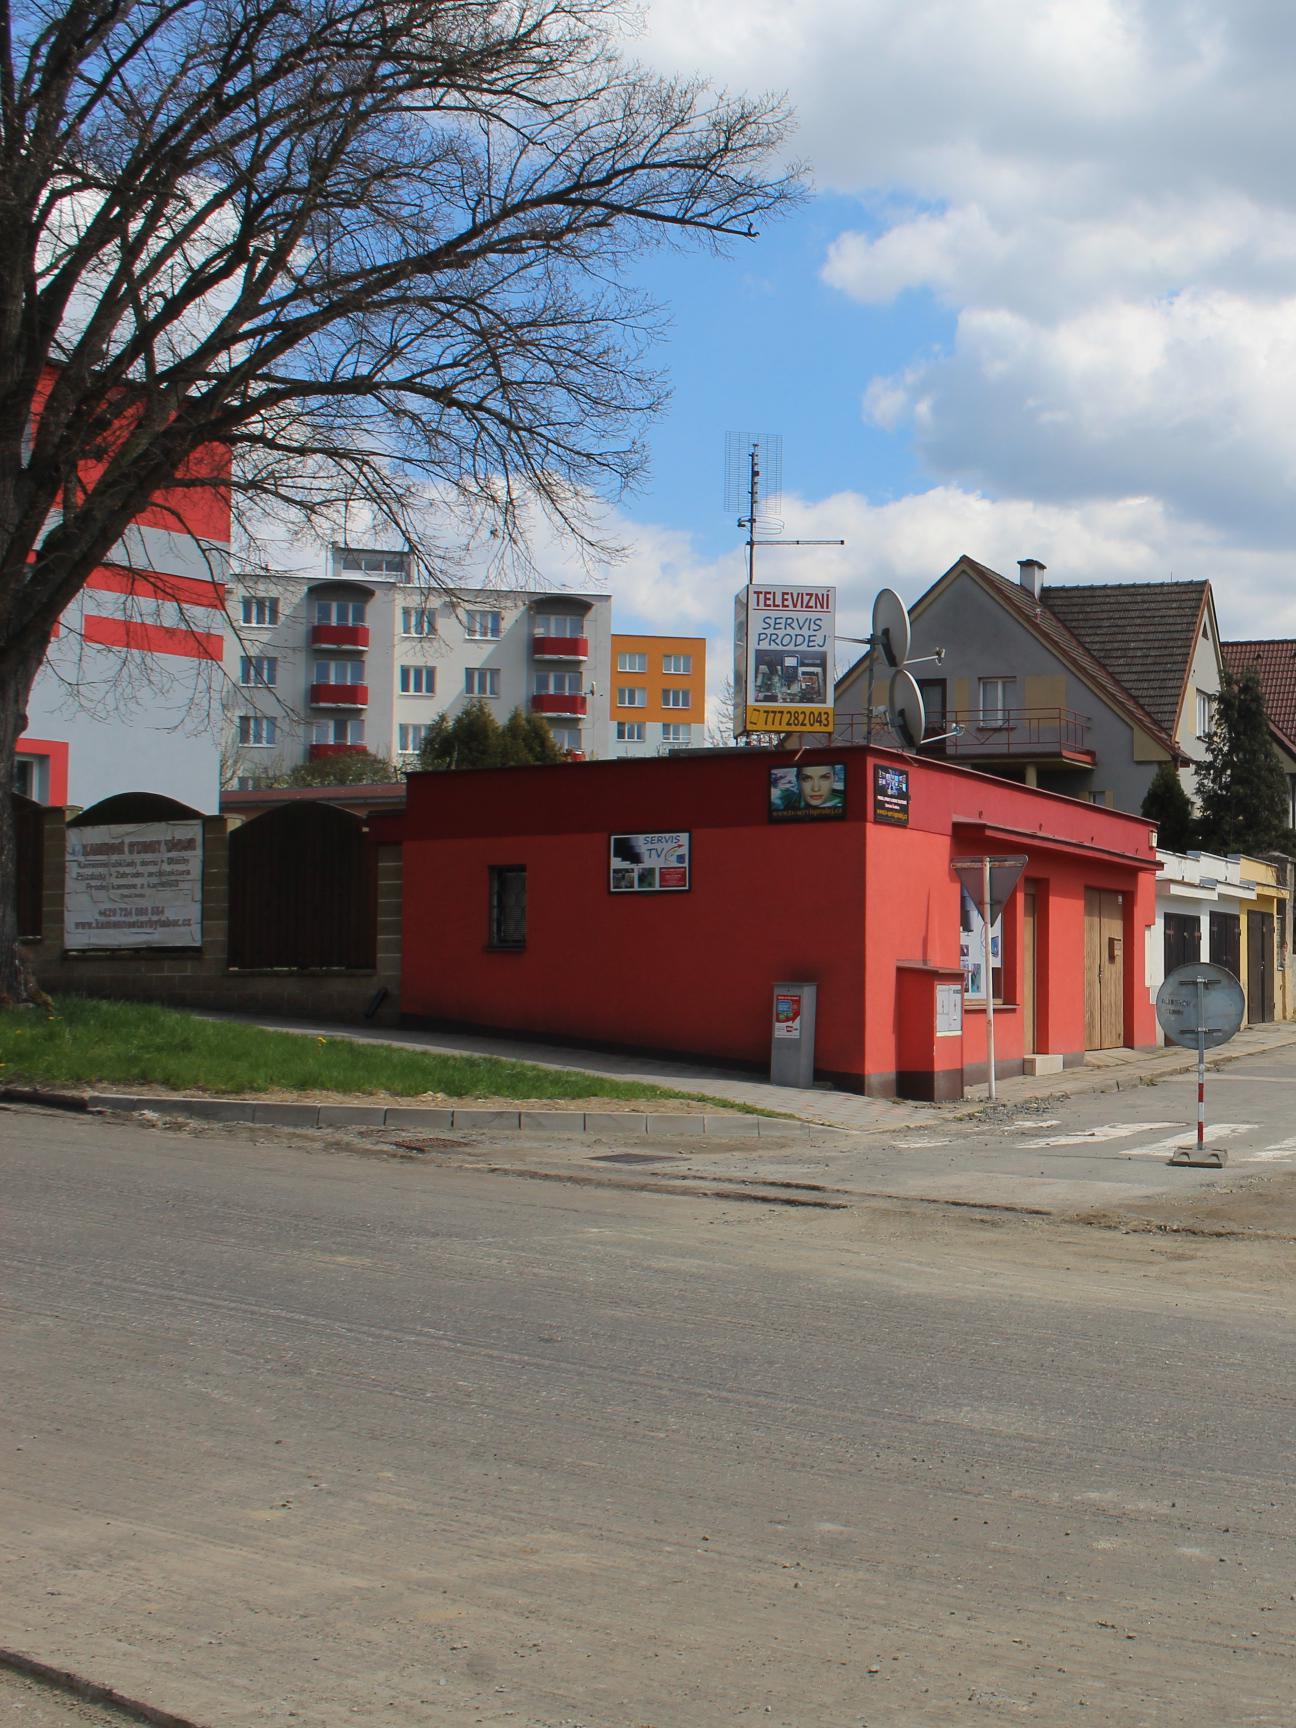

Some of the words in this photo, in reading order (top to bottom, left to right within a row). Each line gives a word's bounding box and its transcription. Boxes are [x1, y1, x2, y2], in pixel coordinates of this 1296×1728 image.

[753, 589, 831, 610] TELEVIZNÍ
[761, 616, 823, 632] SERVIS
[757, 632, 827, 648] PRODEJ
[643, 834, 681, 845] SERVIS
[646, 847, 665, 859] TV
